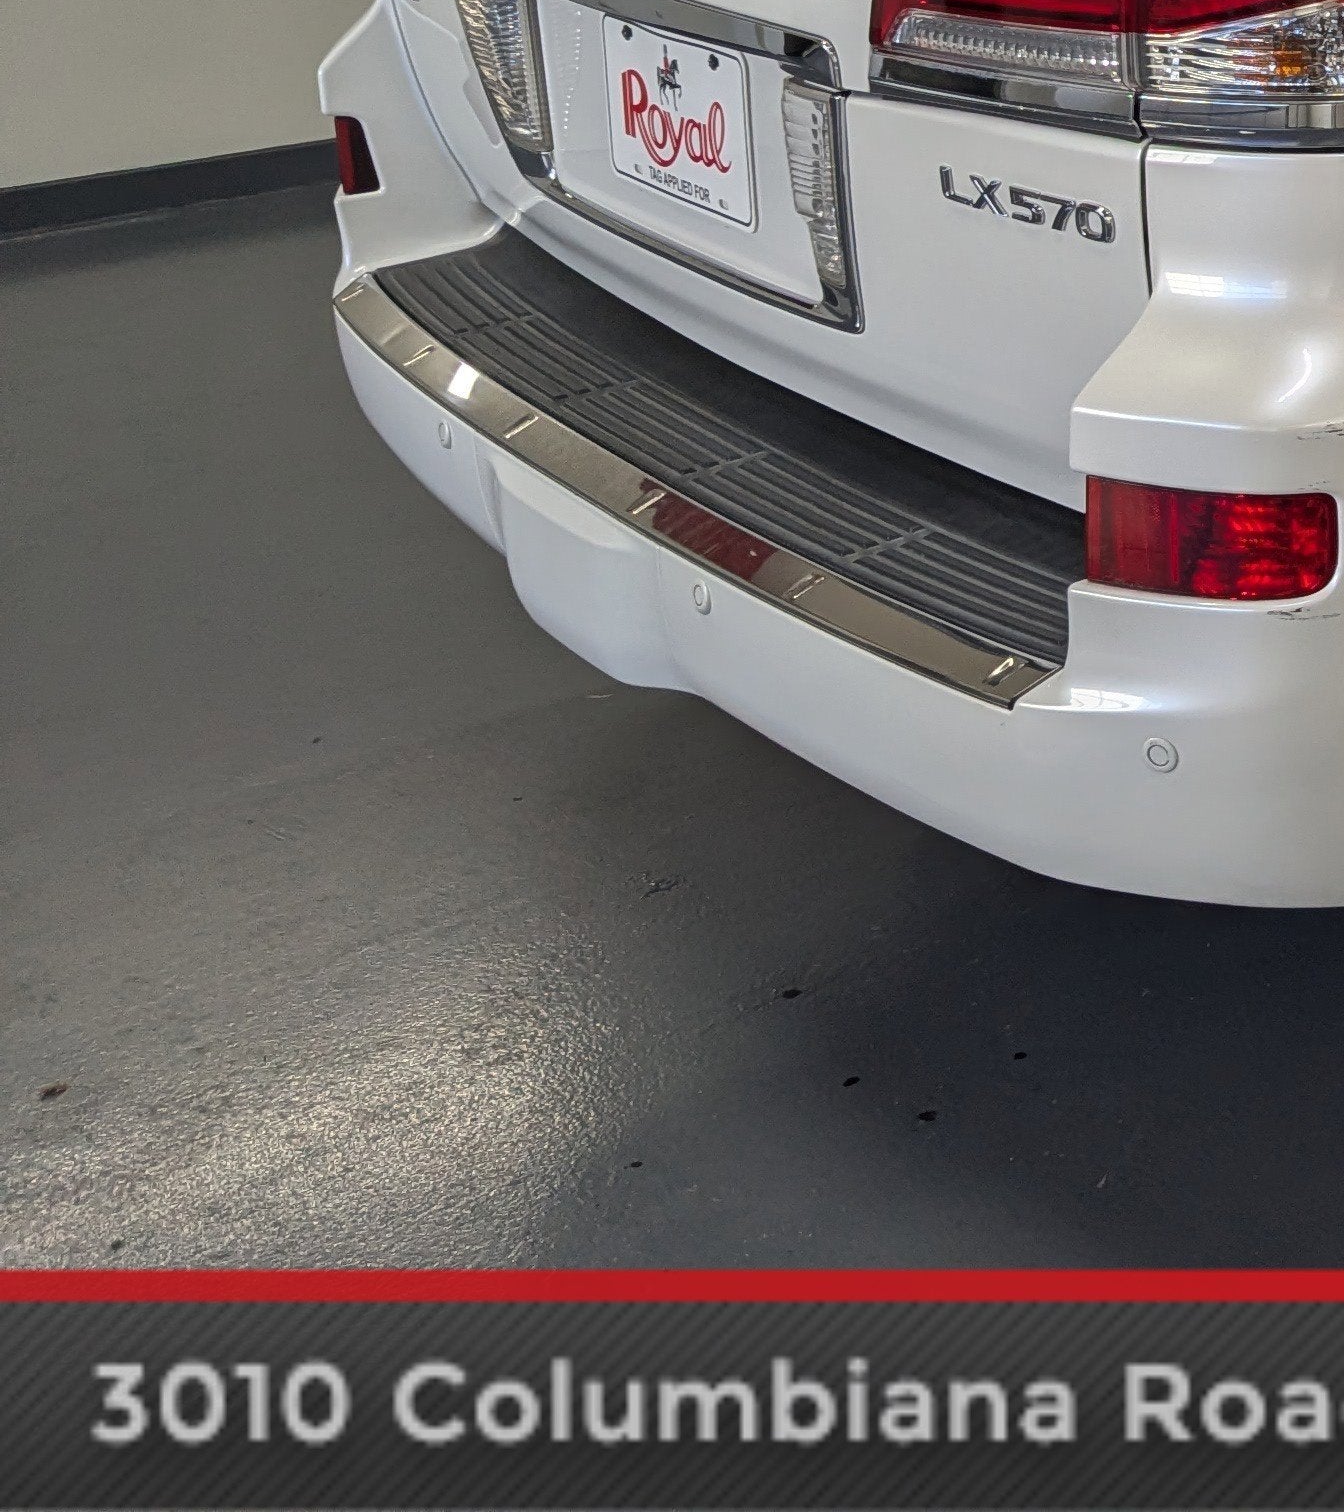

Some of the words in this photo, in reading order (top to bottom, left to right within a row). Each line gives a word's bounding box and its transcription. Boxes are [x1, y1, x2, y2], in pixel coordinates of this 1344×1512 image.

[621, 68, 732, 174] Royal
[649, 165, 663, 183] TAG
[663, 173, 693, 196] APPLIED
[694, 184, 711, 203] FOR
[938, 163, 1117, 244] LX570
